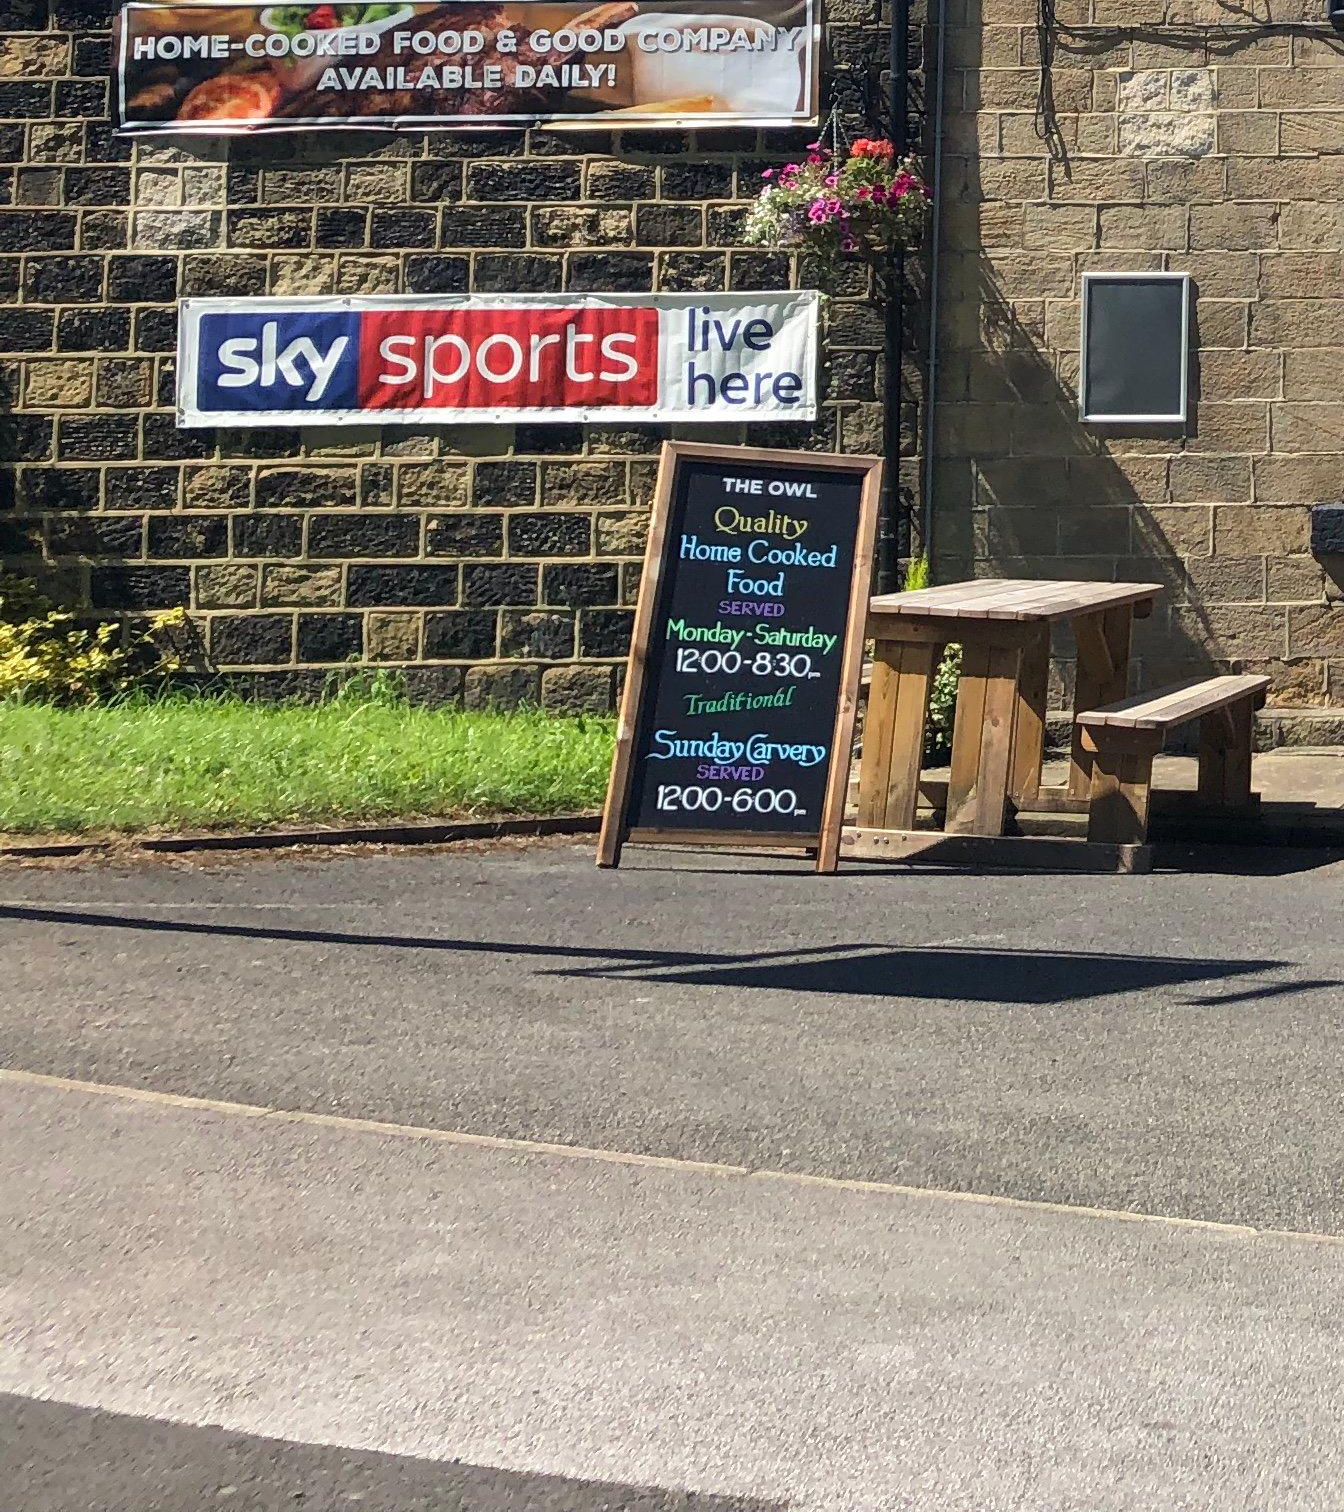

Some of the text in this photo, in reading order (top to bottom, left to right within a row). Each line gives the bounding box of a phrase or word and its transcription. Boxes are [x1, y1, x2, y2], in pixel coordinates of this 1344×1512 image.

[133, 25, 804, 61] HOME-COOKED FOOD & GOOD COMPANY
[316, 63, 616, 91] AVAILABLE DAILY!
[688, 306, 774, 352] live
[217, 321, 638, 402] sky sports
[688, 361, 803, 406] here
[722, 477, 818, 498] THE OWL
[714, 506, 809, 540] Quality
[680, 534, 838, 568] Home Cooked
[727, 568, 785, 597] Food
[718, 600, 785, 618] SERVED
[683, 686, 797, 716] Traditional
[644, 729, 826, 767] Sunday Carvery
[696, 764, 765, 781] SERVED
